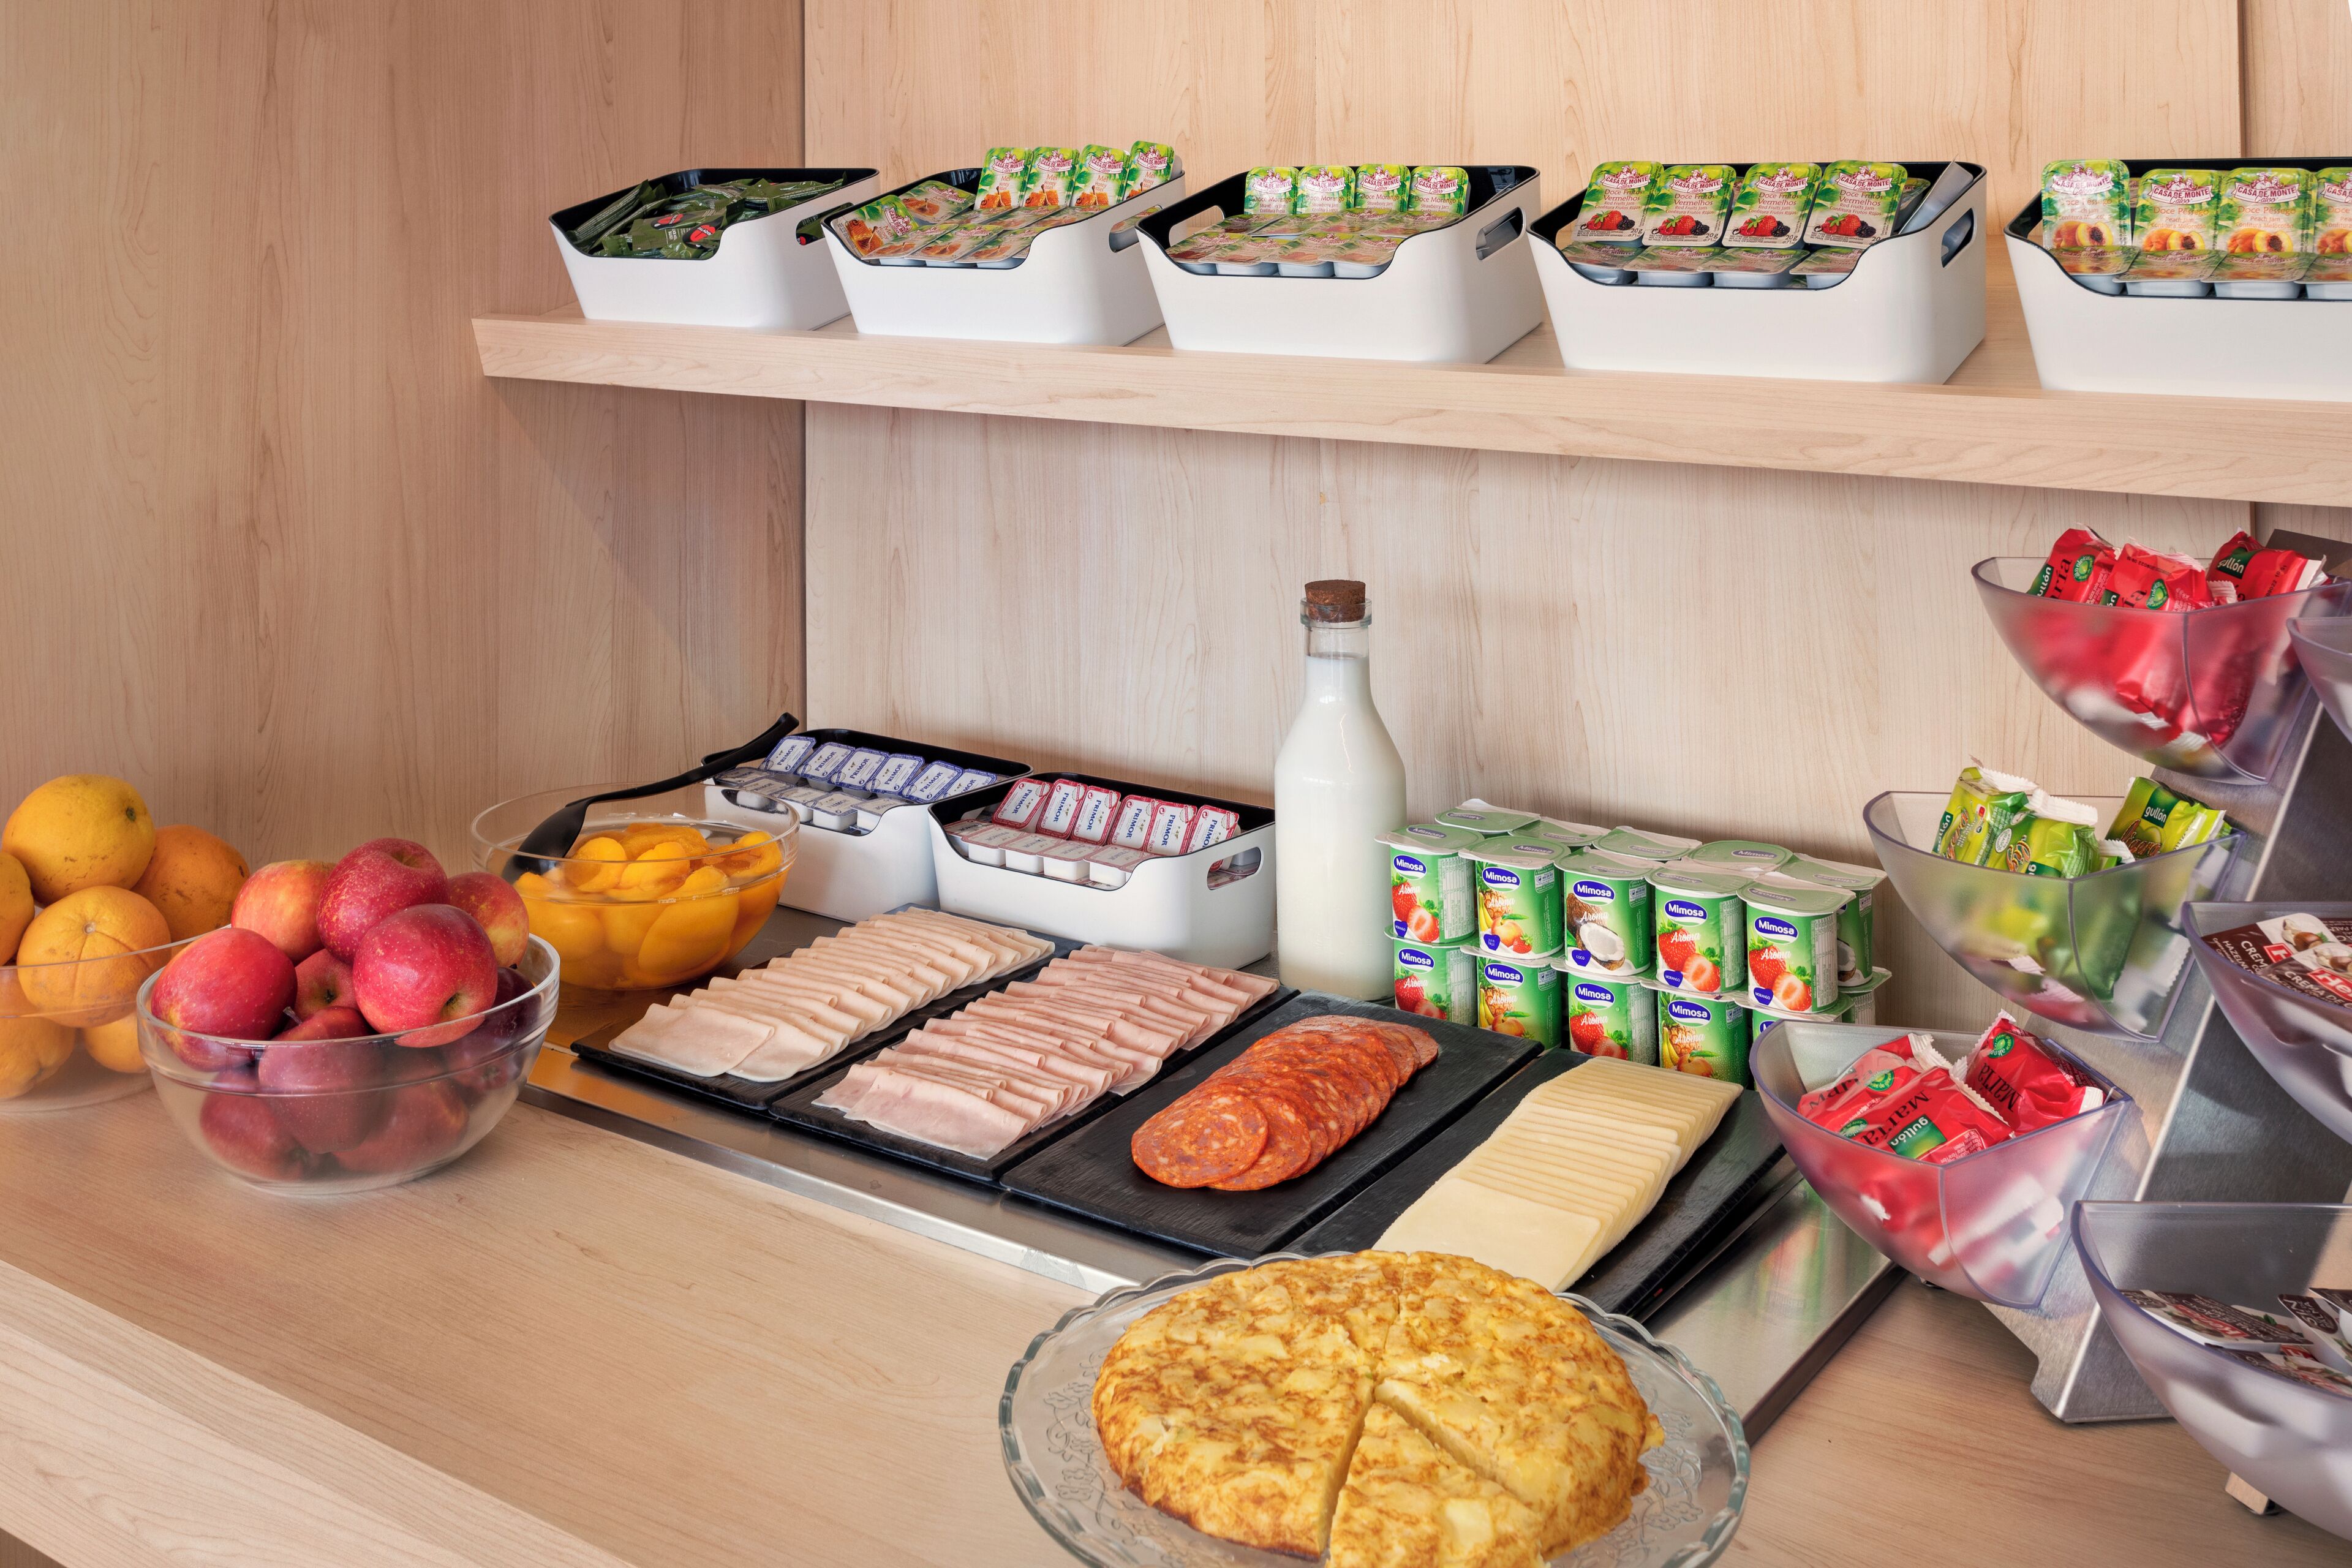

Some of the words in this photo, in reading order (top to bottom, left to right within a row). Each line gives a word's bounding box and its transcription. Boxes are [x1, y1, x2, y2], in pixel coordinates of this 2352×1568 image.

[1419, 180, 1431, 189] CASA
[1760, 179, 1775, 187] CASA
[1841, 176, 1856, 186] CASA
[2154, 187, 2172, 197] CASA
[2185, 189, 2209, 198] MONTE
[2237, 186, 2256, 196] CASA
[2270, 187, 2296, 197] MONTE
[2327, 187, 2346, 196] CASA
[1839, 196, 1880, 206] Vermelhos
[2169, 195, 2190, 204] Calvo
[2255, 194, 2275, 203] Calvo
[2218, 557, 2244, 573] gullón
[2037, 567, 2051, 597] ullón
[777, 744, 797, 766] PRIMOR
[815, 751, 837, 771] PRIMOR
[850, 758, 870, 779] PRIMOR
[884, 763, 903, 785] PRIMOR
[919, 771, 943, 793] PRIMOR
[960, 779, 976, 793] MOR
[1012, 789, 1032, 815] PRIMOR
[1053, 793, 1069, 823] PRIMOR
[1086, 799, 1101, 831] PRIMOR
[2144, 805, 2167, 823] gullón
[1126, 808, 1142, 839] PRIMOR
[1161, 814, 1176, 846] PRIMOR
[1202, 819, 1218, 848] PRIMO
[1412, 828, 1445, 839] Mimosa
[1518, 845, 1553, 854] Mimosa
[1738, 850, 1774, 858] Mimosa
[1396, 858, 1424, 871] Mimosa
[1485, 870, 1517, 883] Mimosa
[1398, 884, 1421, 895] Aroma
[1577, 884, 1611, 897] Mimosa
[1489, 897, 1515, 908] Aroma
[1580, 911, 1609, 922] Aroma
[1668, 903, 1704, 917] Mimosa
[1758, 919, 1795, 935] Mimosa
[1671, 932, 1701, 943] Aroma
[1401, 951, 1431, 965] Mimosa
[1760, 949, 1792, 960] Aroma
[2222, 940, 2254, 974] HAZELNU
[2241, 940, 2269, 968] CREM
[1488, 967, 1520, 981] Mimosa
[1404, 978, 1428, 989] Aroma
[2285, 971, 2326, 997] CREMA
[1490, 993, 1518, 1005] Aroma
[1578, 986, 1611, 1000] Mimosa
[1754, 991, 1771, 1001] MORANGO
[1672, 1005, 1708, 1018] Mimosa
[1581, 1015, 1608, 1025] Aroma
[1675, 1033, 1705, 1044] Aroma
[1891, 1117, 1929, 1146] gullón
